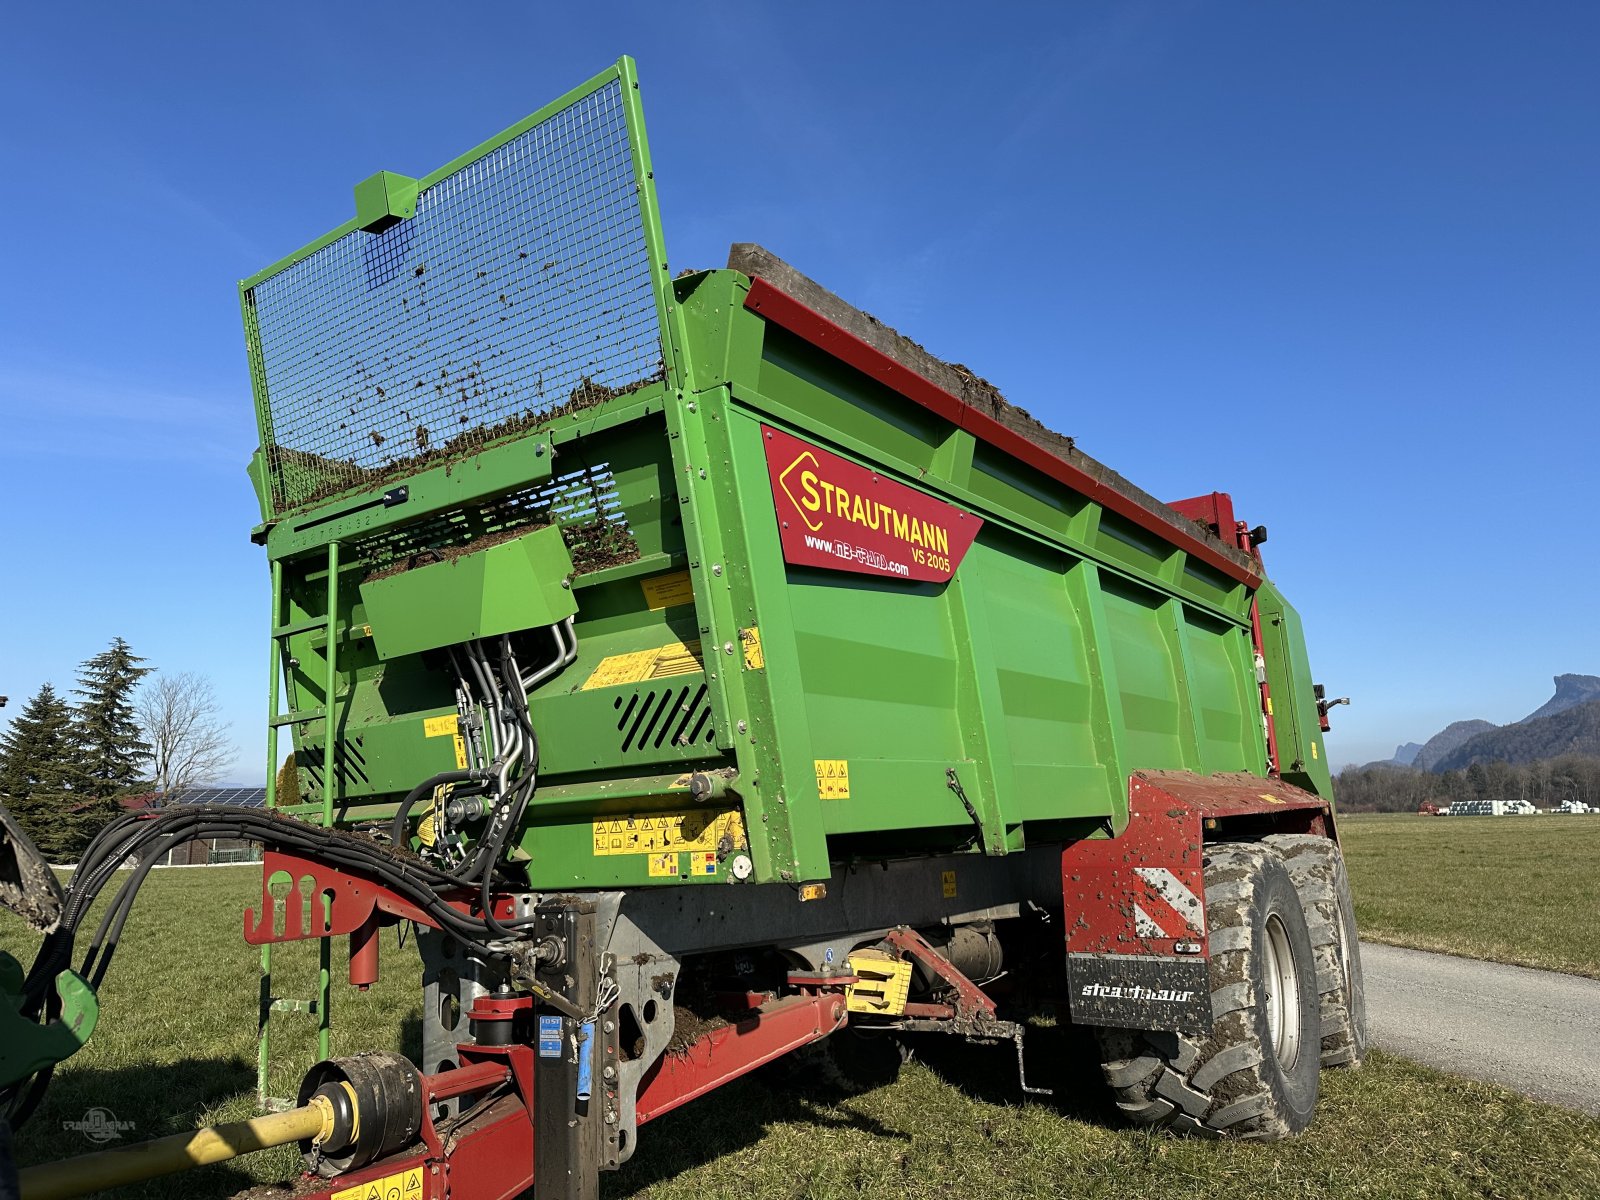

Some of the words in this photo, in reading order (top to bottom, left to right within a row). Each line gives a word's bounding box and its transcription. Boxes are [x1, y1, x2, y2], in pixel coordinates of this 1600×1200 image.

[800, 470, 949, 556] STRAUTMANN
[911, 546, 926, 565] VS
[926, 552, 951, 573] 2005
